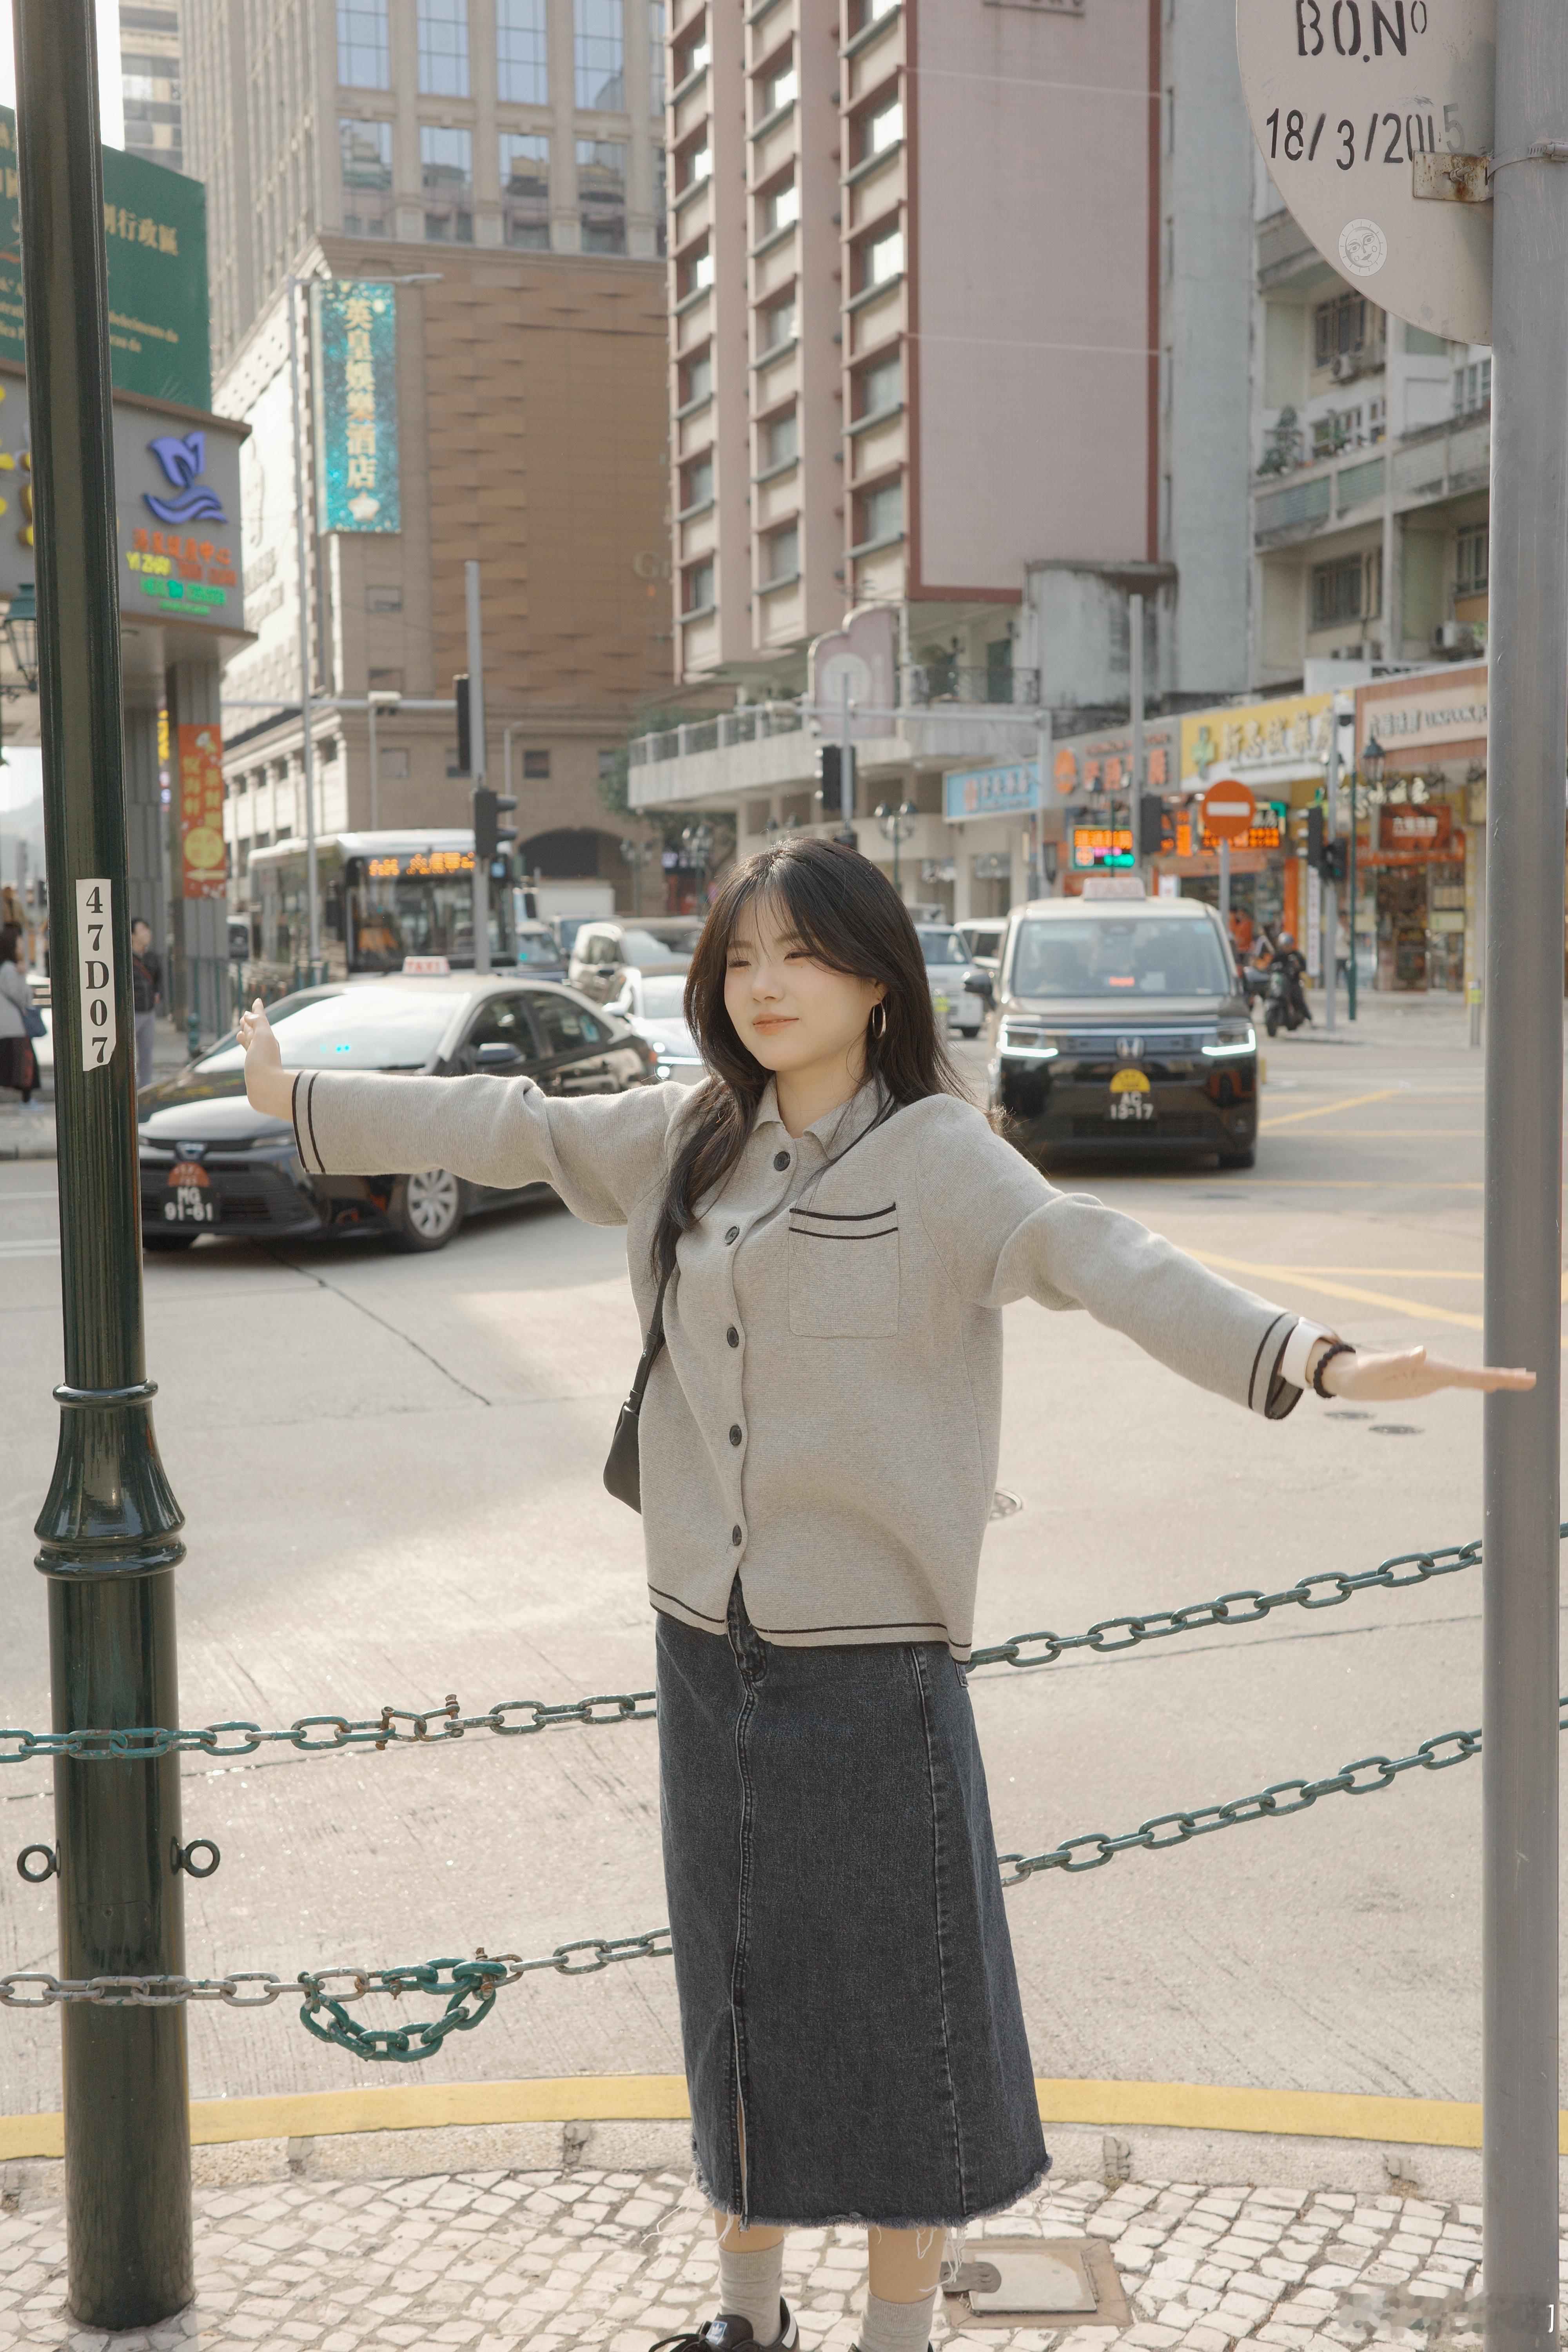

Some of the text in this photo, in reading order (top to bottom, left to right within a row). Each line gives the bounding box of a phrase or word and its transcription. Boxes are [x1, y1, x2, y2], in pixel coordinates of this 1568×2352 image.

[343, 297, 377, 489] 英皇娛樂酒店
[1089, 881, 1139, 896] TAXI
[85, 886, 109, 1063] 47D07
[406, 961, 441, 973] TAXI
